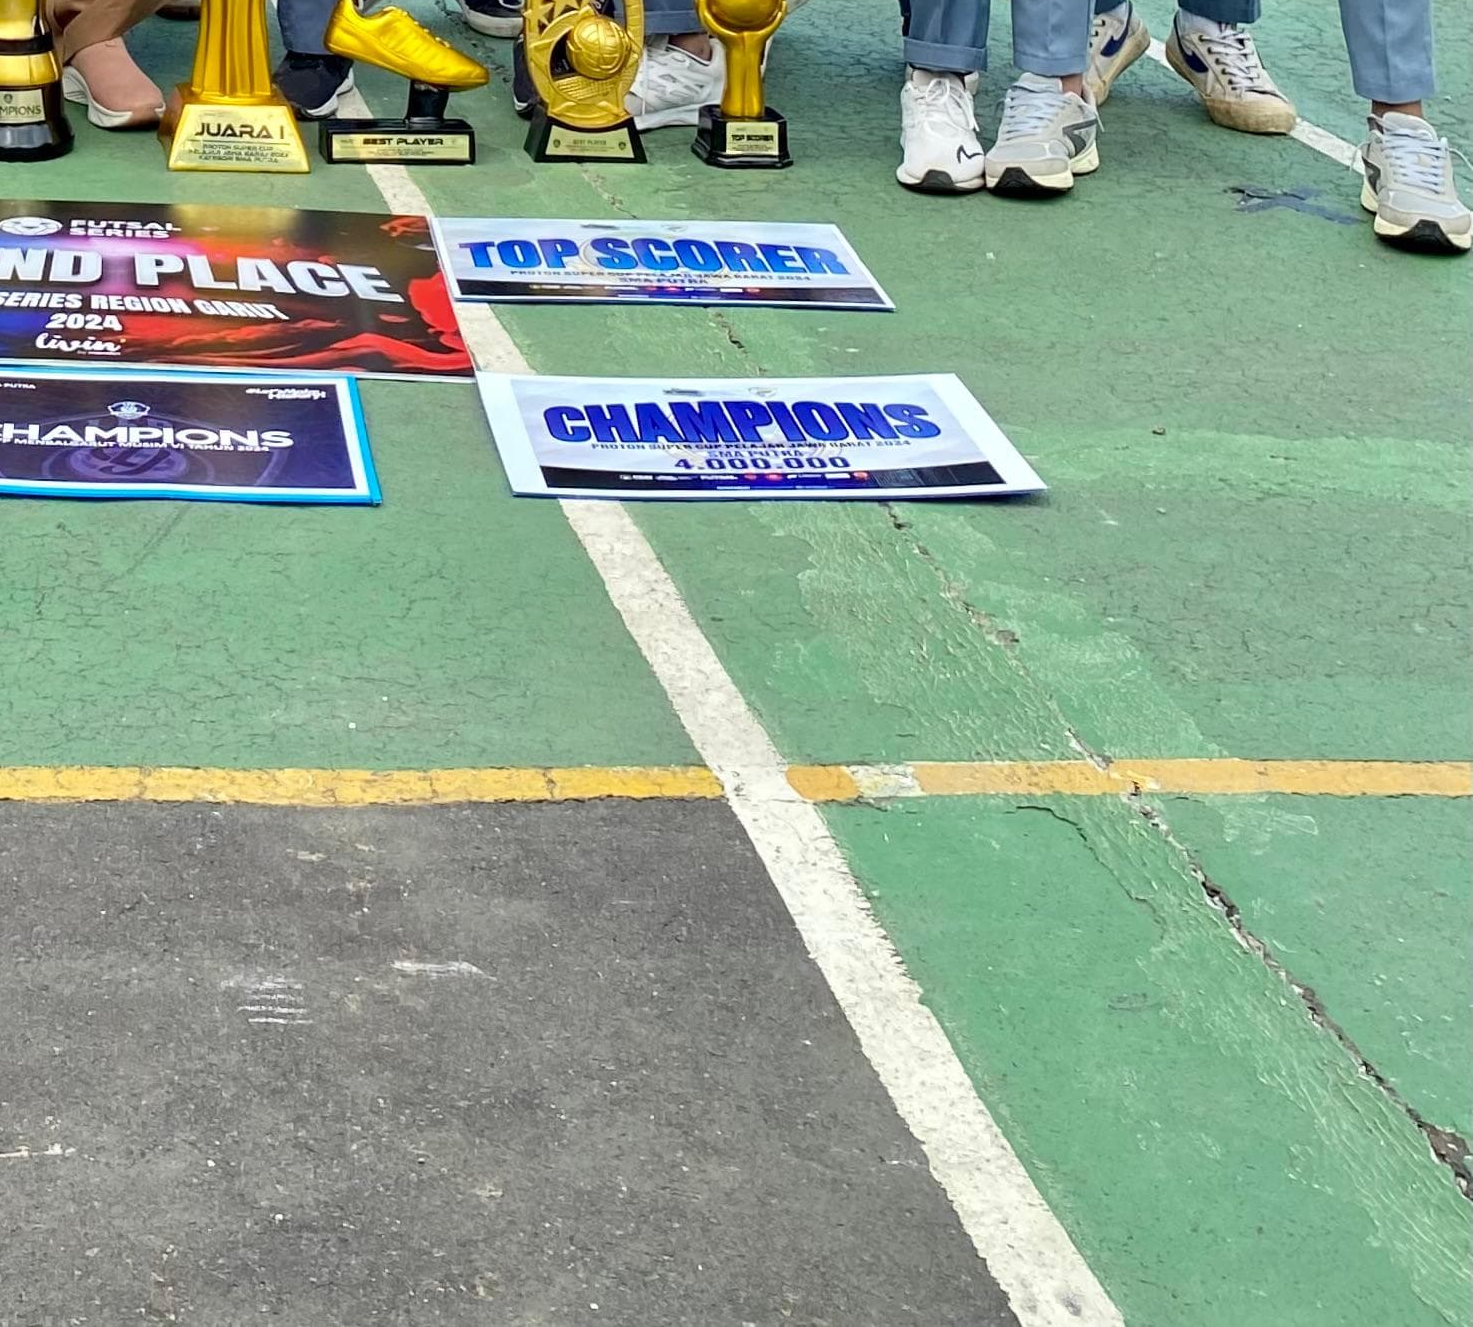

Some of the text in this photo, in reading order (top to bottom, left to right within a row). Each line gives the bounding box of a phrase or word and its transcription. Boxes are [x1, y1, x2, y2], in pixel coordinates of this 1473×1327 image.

[194, 122, 274, 140] JUARA
[362, 137, 444, 146] BEST PLAYER
[69, 219, 183, 231] FUTSAL
[69, 228, 171, 239] SERIES
[458, 237, 851, 275] TOP SCORER
[134, 250, 405, 304] PLACE
[90, 294, 193, 315] REGION
[193, 299, 291, 321] GARUT
[45, 312, 123, 332] 2024
[543, 400, 941, 444] CHAMPIONS
[874, 439, 913, 448] 2024
[706, 449, 804, 458] SMA PUTRA
[674, 456, 851, 471] 4.000.000
